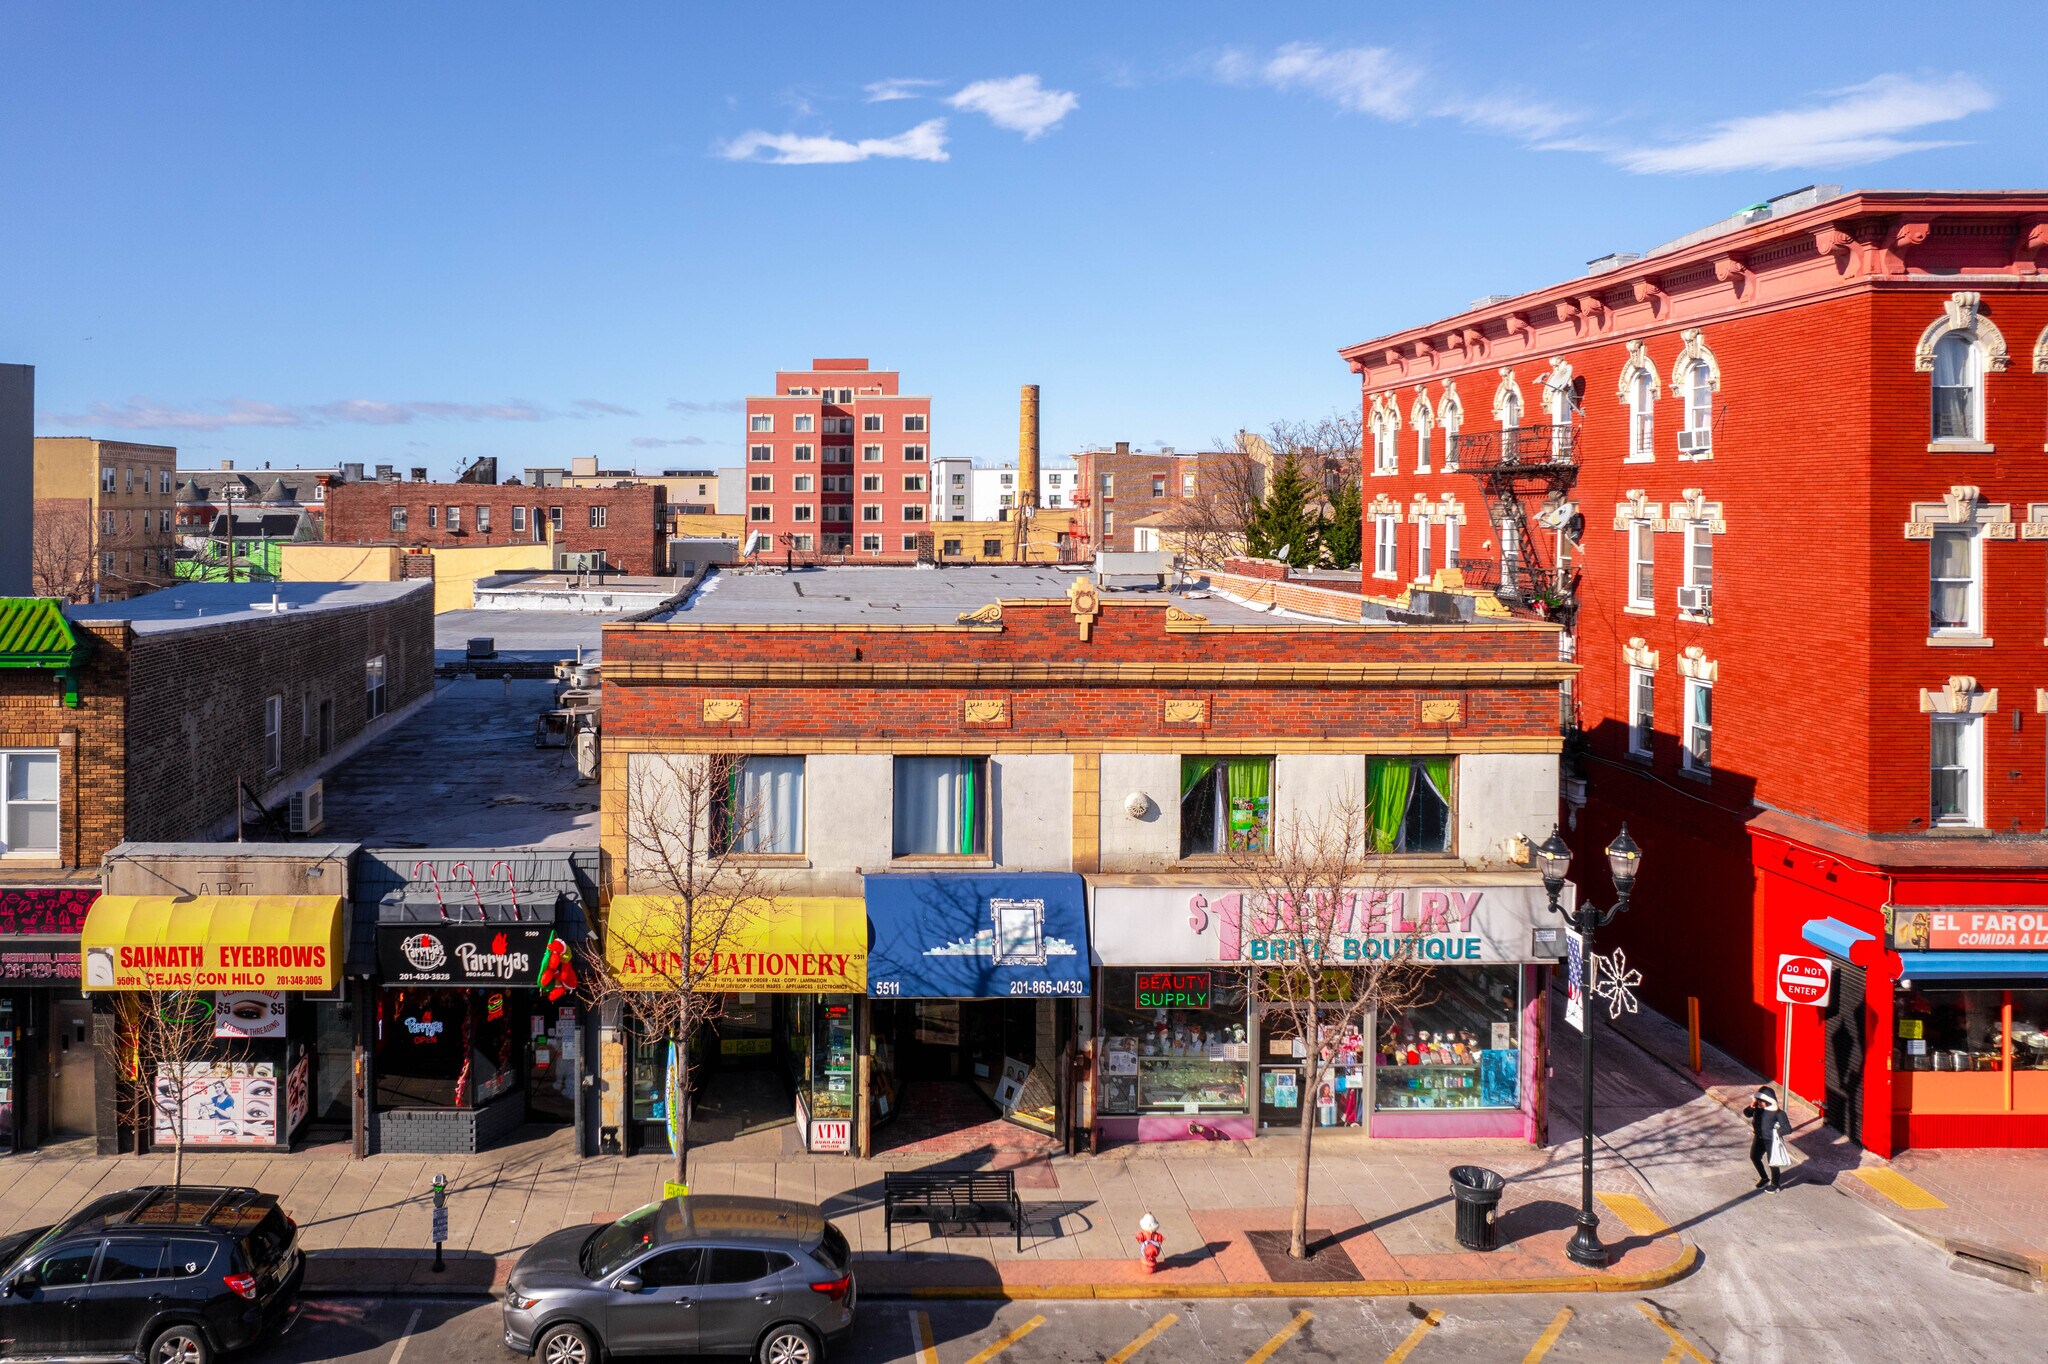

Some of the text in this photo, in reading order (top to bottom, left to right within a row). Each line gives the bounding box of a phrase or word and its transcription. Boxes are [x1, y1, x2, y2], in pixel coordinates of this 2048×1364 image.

[1189, 892, 1484, 961] $1 JEWELRY
[1932, 914, 1960, 931] EL
[1971, 914, 2048, 931] FAROL
[1958, 933, 2015, 945] COMIDA
[2019, 933, 2030, 945] A
[1343, 938, 1482, 960] BOUTIQUE
[120, 945, 326, 968] SAINATH EYEBROWS
[621, 951, 850, 976] AMIN STATIONERY
[1786, 964, 1822, 976] DO NOT
[117, 977, 135, 986] 5509
[146, 972, 192, 985] CEJAS
[196, 972, 227, 985] CON
[232, 972, 265, 985] HILO
[276, 975, 323, 985] 201-348-3005
[1140, 976, 1207, 990] BEAUTY
[876, 980, 1083, 995] 5511 201-865-0430
[1788, 986, 1817, 996] ENTER
[1140, 992, 1207, 1006] SUPPLY
[217, 1002, 285, 1015] $5 $5
[222, 1020, 280, 1036] EYEBROW THREADING
[816, 1124, 846, 1138] ATM
